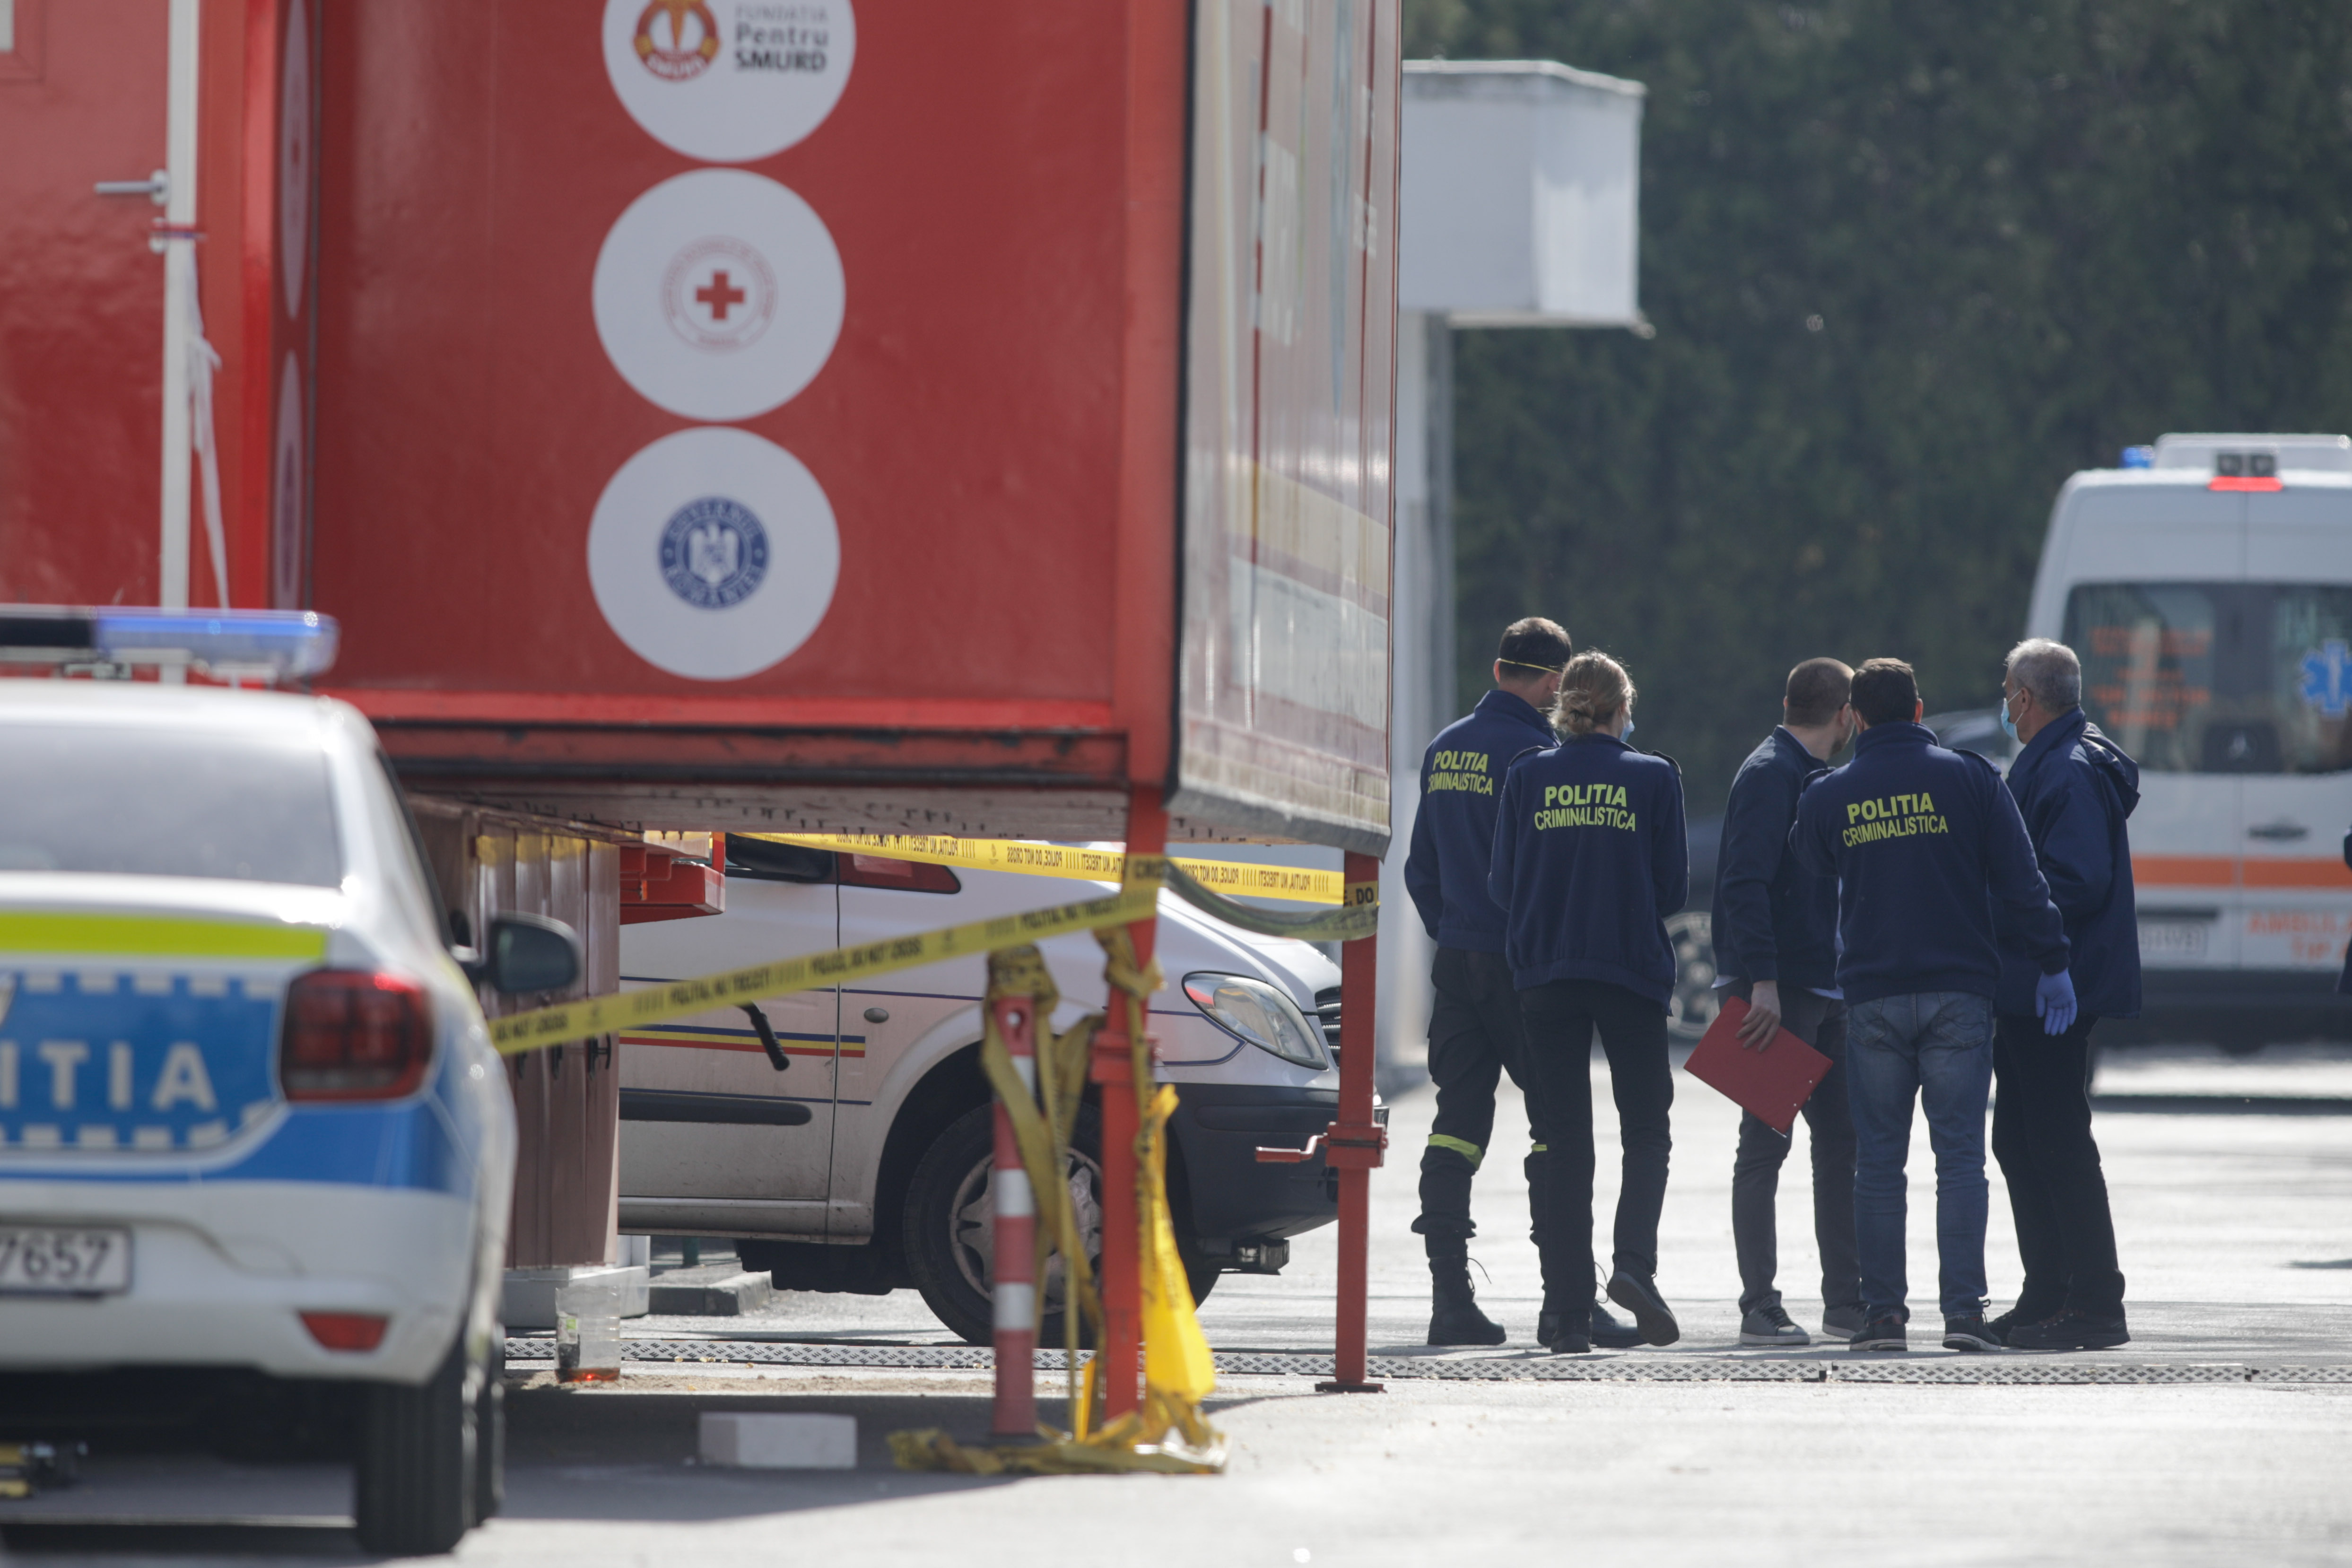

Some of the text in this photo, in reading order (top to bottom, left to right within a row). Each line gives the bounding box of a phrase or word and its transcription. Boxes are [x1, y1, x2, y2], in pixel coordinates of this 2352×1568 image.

[735, 23, 828, 47] Pentru
[734, 49, 827, 72] SMURD
[1433, 750, 1489, 773] POLITIA
[1545, 784, 1627, 807] POLITIA
[1534, 807, 1636, 831] CRIMINALISTICA
[1847, 793, 1934, 824] POLITIA
[1843, 815, 1949, 847] CRIMINALISTICA
[1356, 887, 1374, 904] DO
